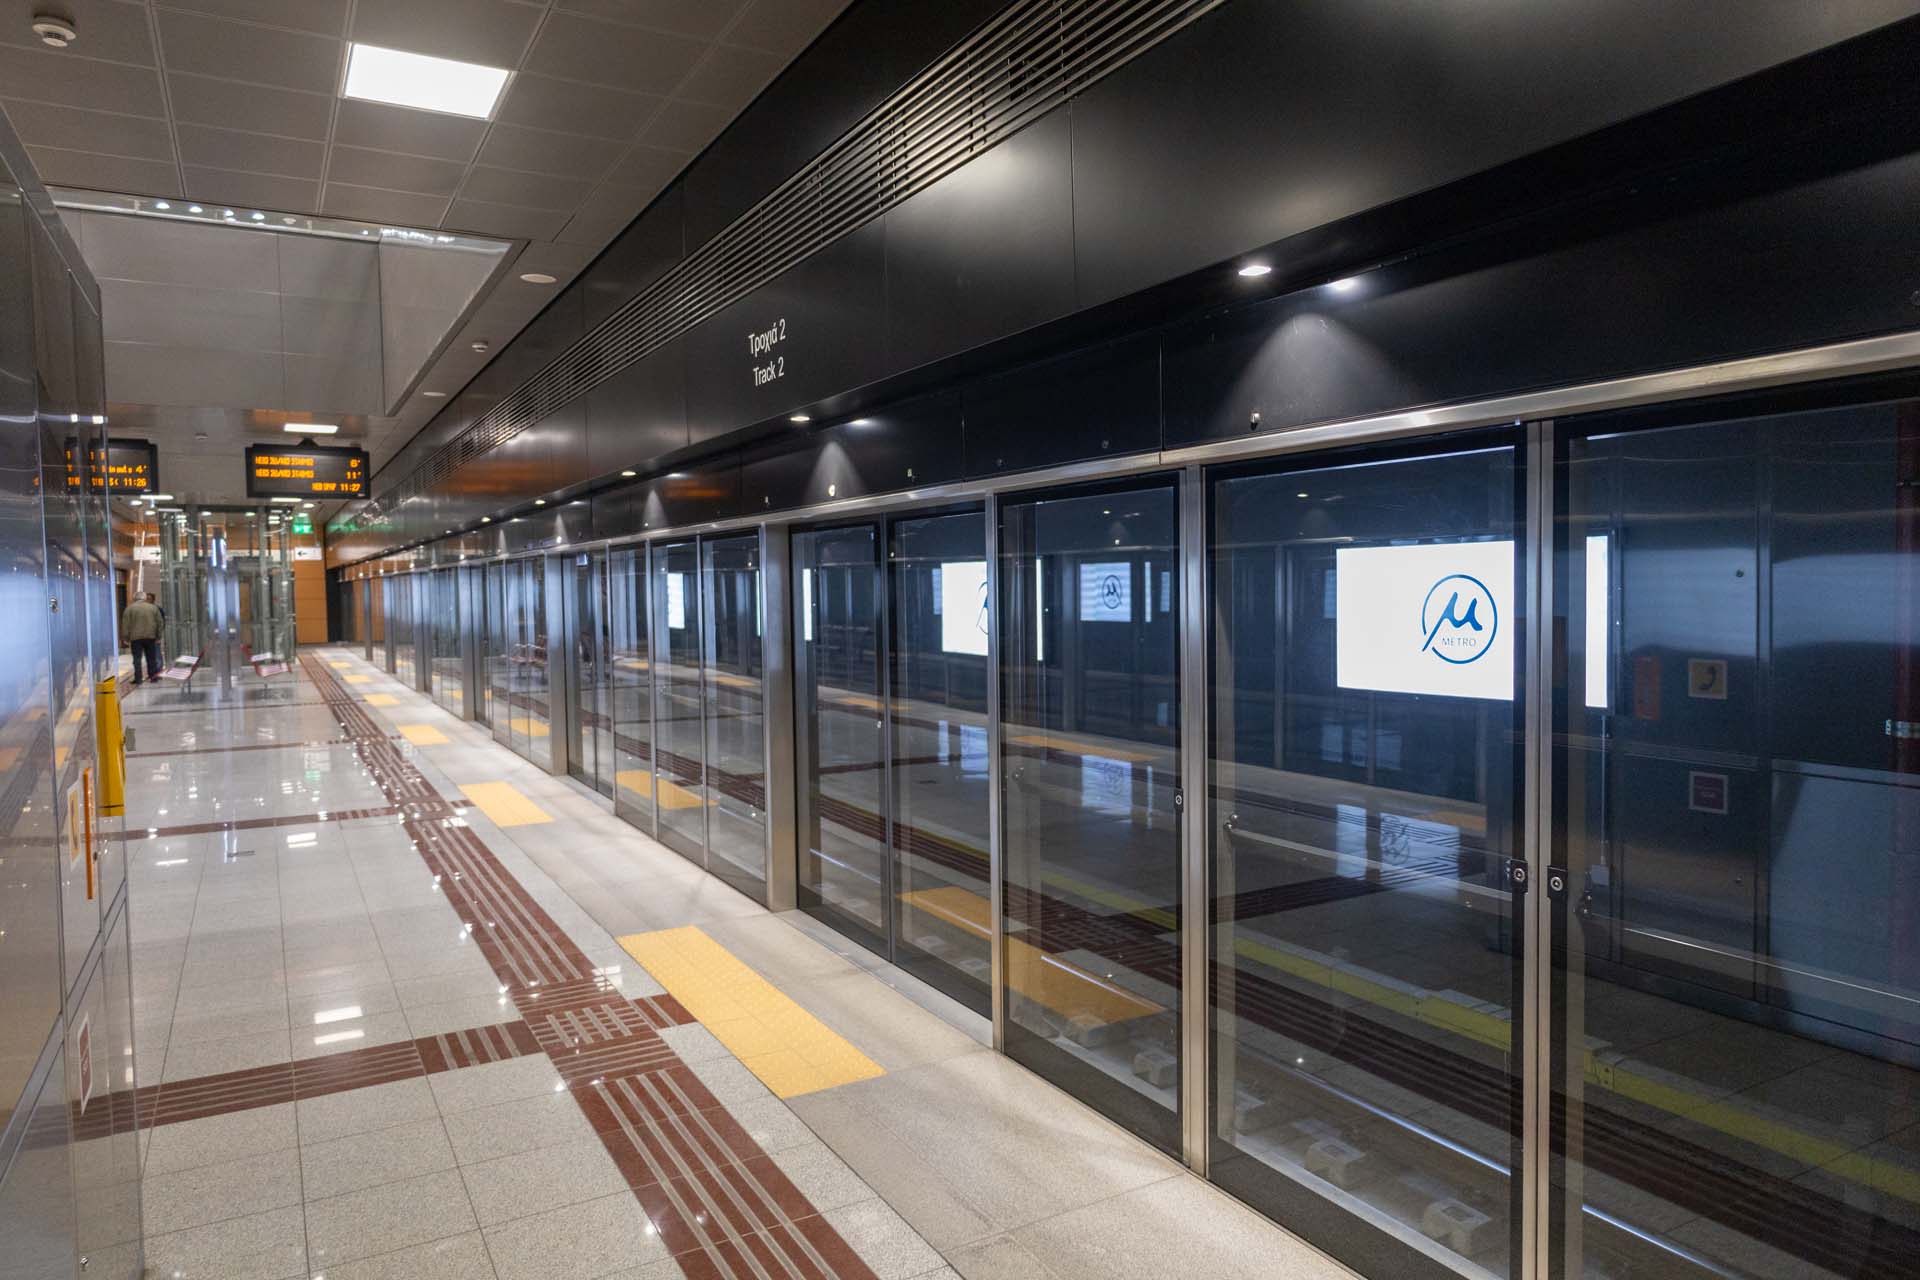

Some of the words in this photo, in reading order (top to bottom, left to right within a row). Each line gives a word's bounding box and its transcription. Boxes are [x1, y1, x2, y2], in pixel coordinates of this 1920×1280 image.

[748, 322, 778, 357] Τροχιά
[779, 318, 786, 341] 2
[753, 361, 776, 387] Track
[778, 356, 785, 377] 2
[1442, 637, 1477, 648] METRO
